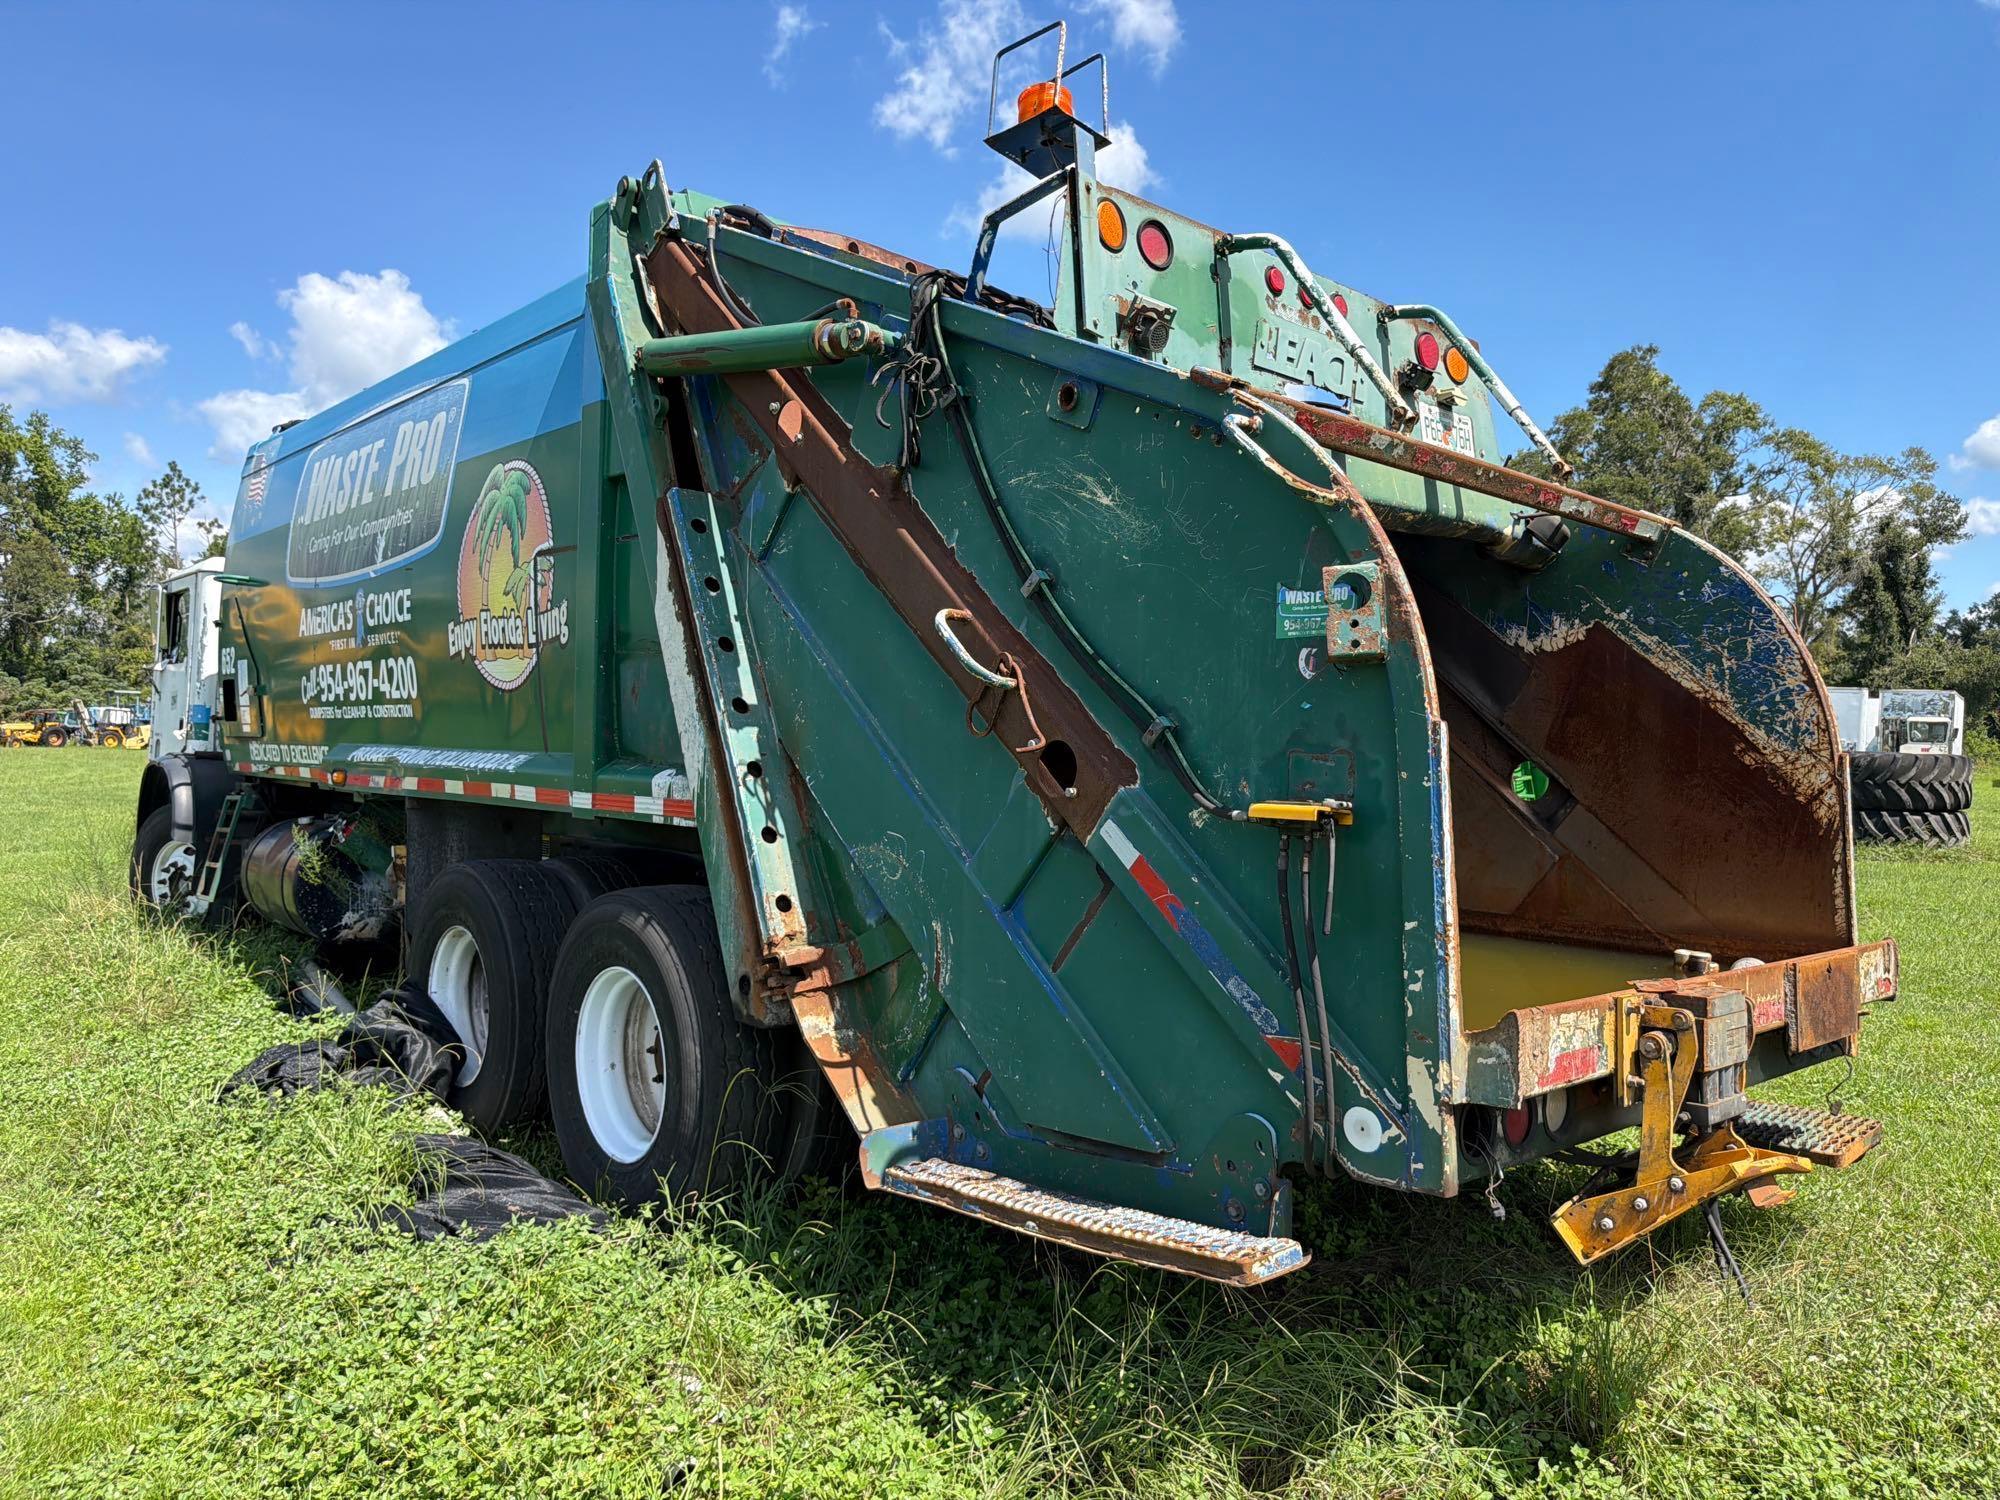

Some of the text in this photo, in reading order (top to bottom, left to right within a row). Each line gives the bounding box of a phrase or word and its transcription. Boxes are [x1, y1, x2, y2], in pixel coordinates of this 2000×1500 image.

[304, 411, 447, 526] WASTE PRO
[308, 507, 414, 554] Caring For Our Communities
[299, 588, 412, 637] AMERICA'S CHOICE
[1285, 590, 1322, 605] WASTE
[348, 637, 356, 649] IN
[447, 619, 478, 660] Enjoy
[480, 608, 524, 645] Florida
[319, 655, 418, 702] 954-967-4200
[309, 706, 335, 719] DUMPSTERS
[342, 705, 366, 719] CLEAN-UP
[367, 705, 373, 718] &
[373, 704, 413, 718] CONSTRUCTION
[249, 741, 280, 762] DEDICATED
[280, 744, 290, 762] TO
